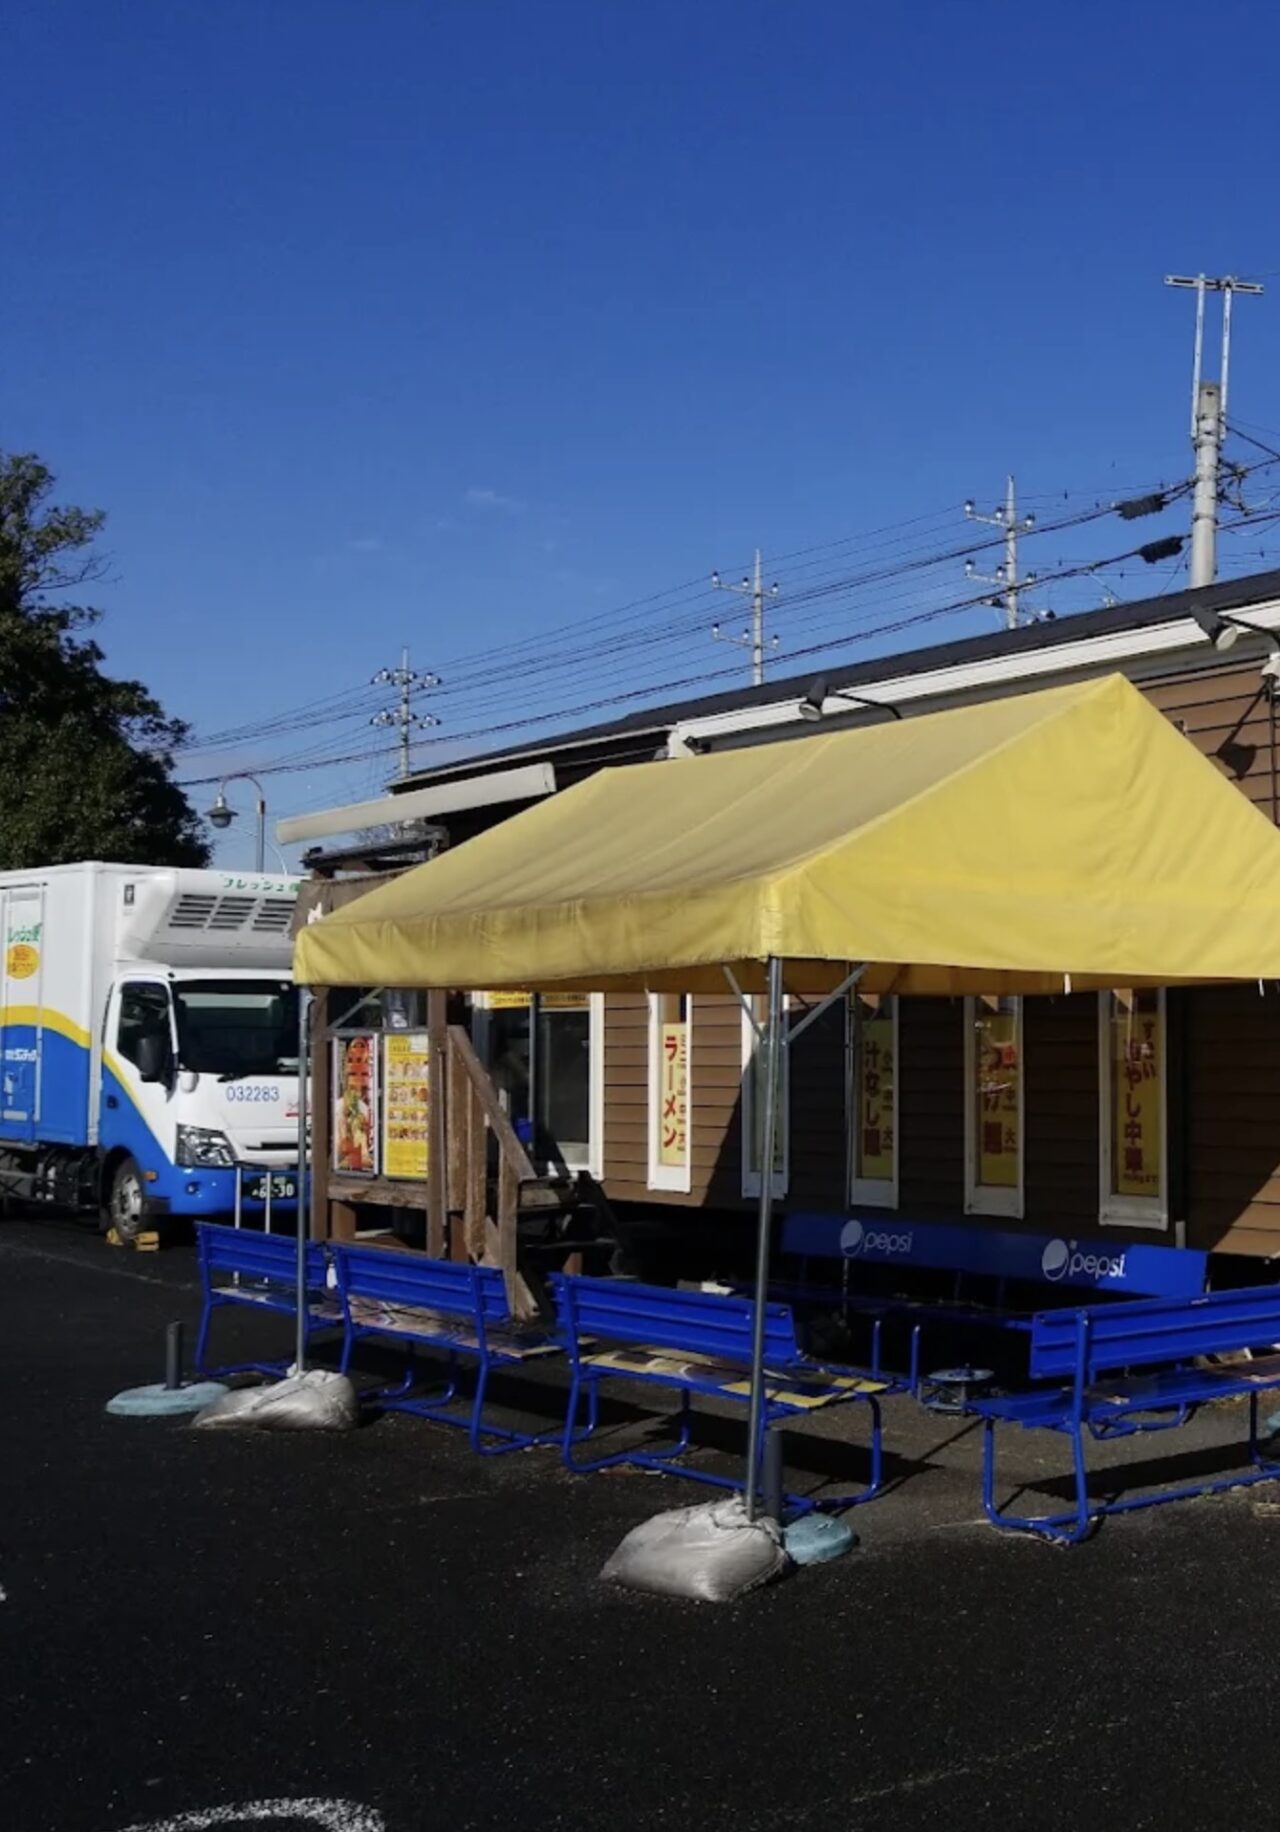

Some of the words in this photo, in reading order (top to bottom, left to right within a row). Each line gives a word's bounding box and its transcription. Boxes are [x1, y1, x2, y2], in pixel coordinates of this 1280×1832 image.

[226, 1085, 281, 1103] 032283
[664, 1035, 680, 1148] ラーメン
[862, 1230, 914, 1257] pepsi
[1068, 1252, 1127, 1280] pepsi
